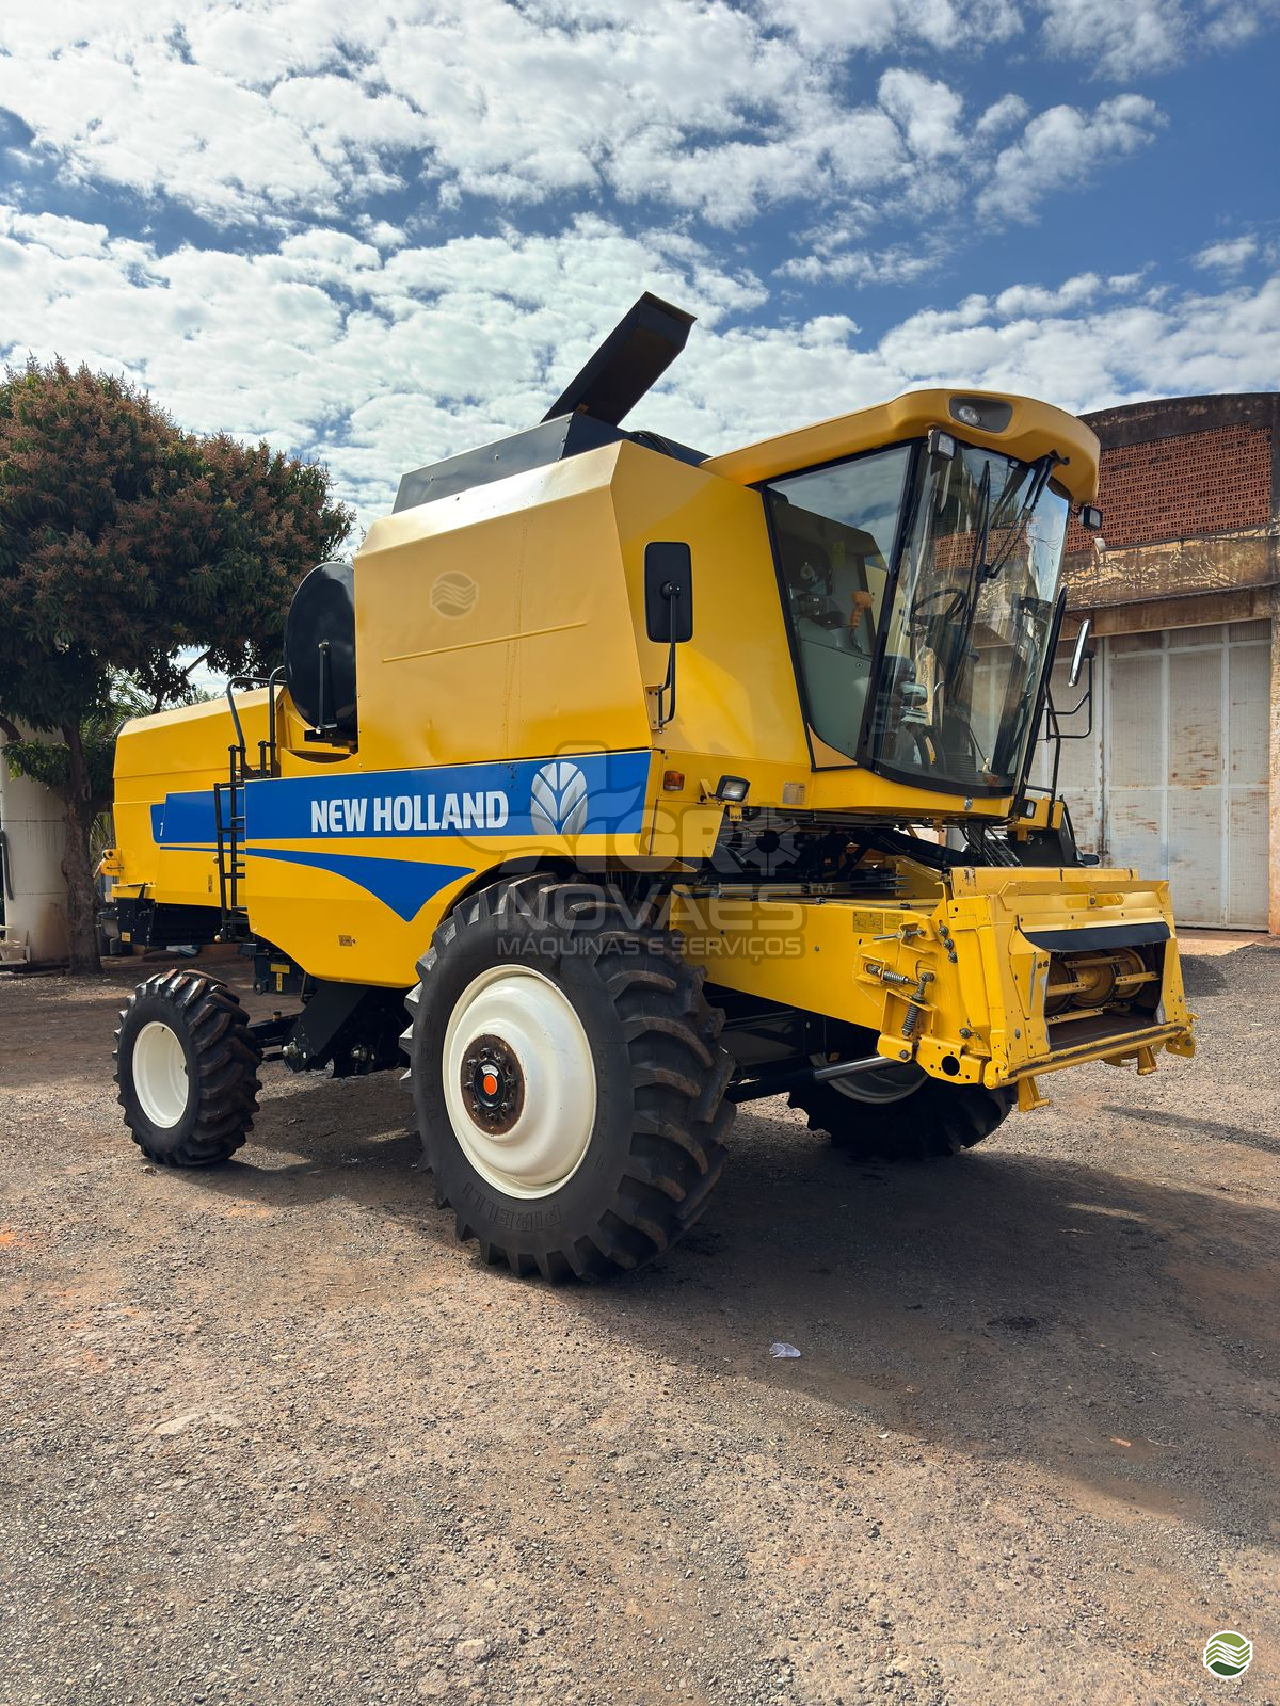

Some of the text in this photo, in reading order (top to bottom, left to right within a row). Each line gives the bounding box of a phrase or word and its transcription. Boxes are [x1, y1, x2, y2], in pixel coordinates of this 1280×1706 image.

[311, 791, 509, 832] NEW HOLLAND
[461, 1179, 564, 1231] PIRELLI
